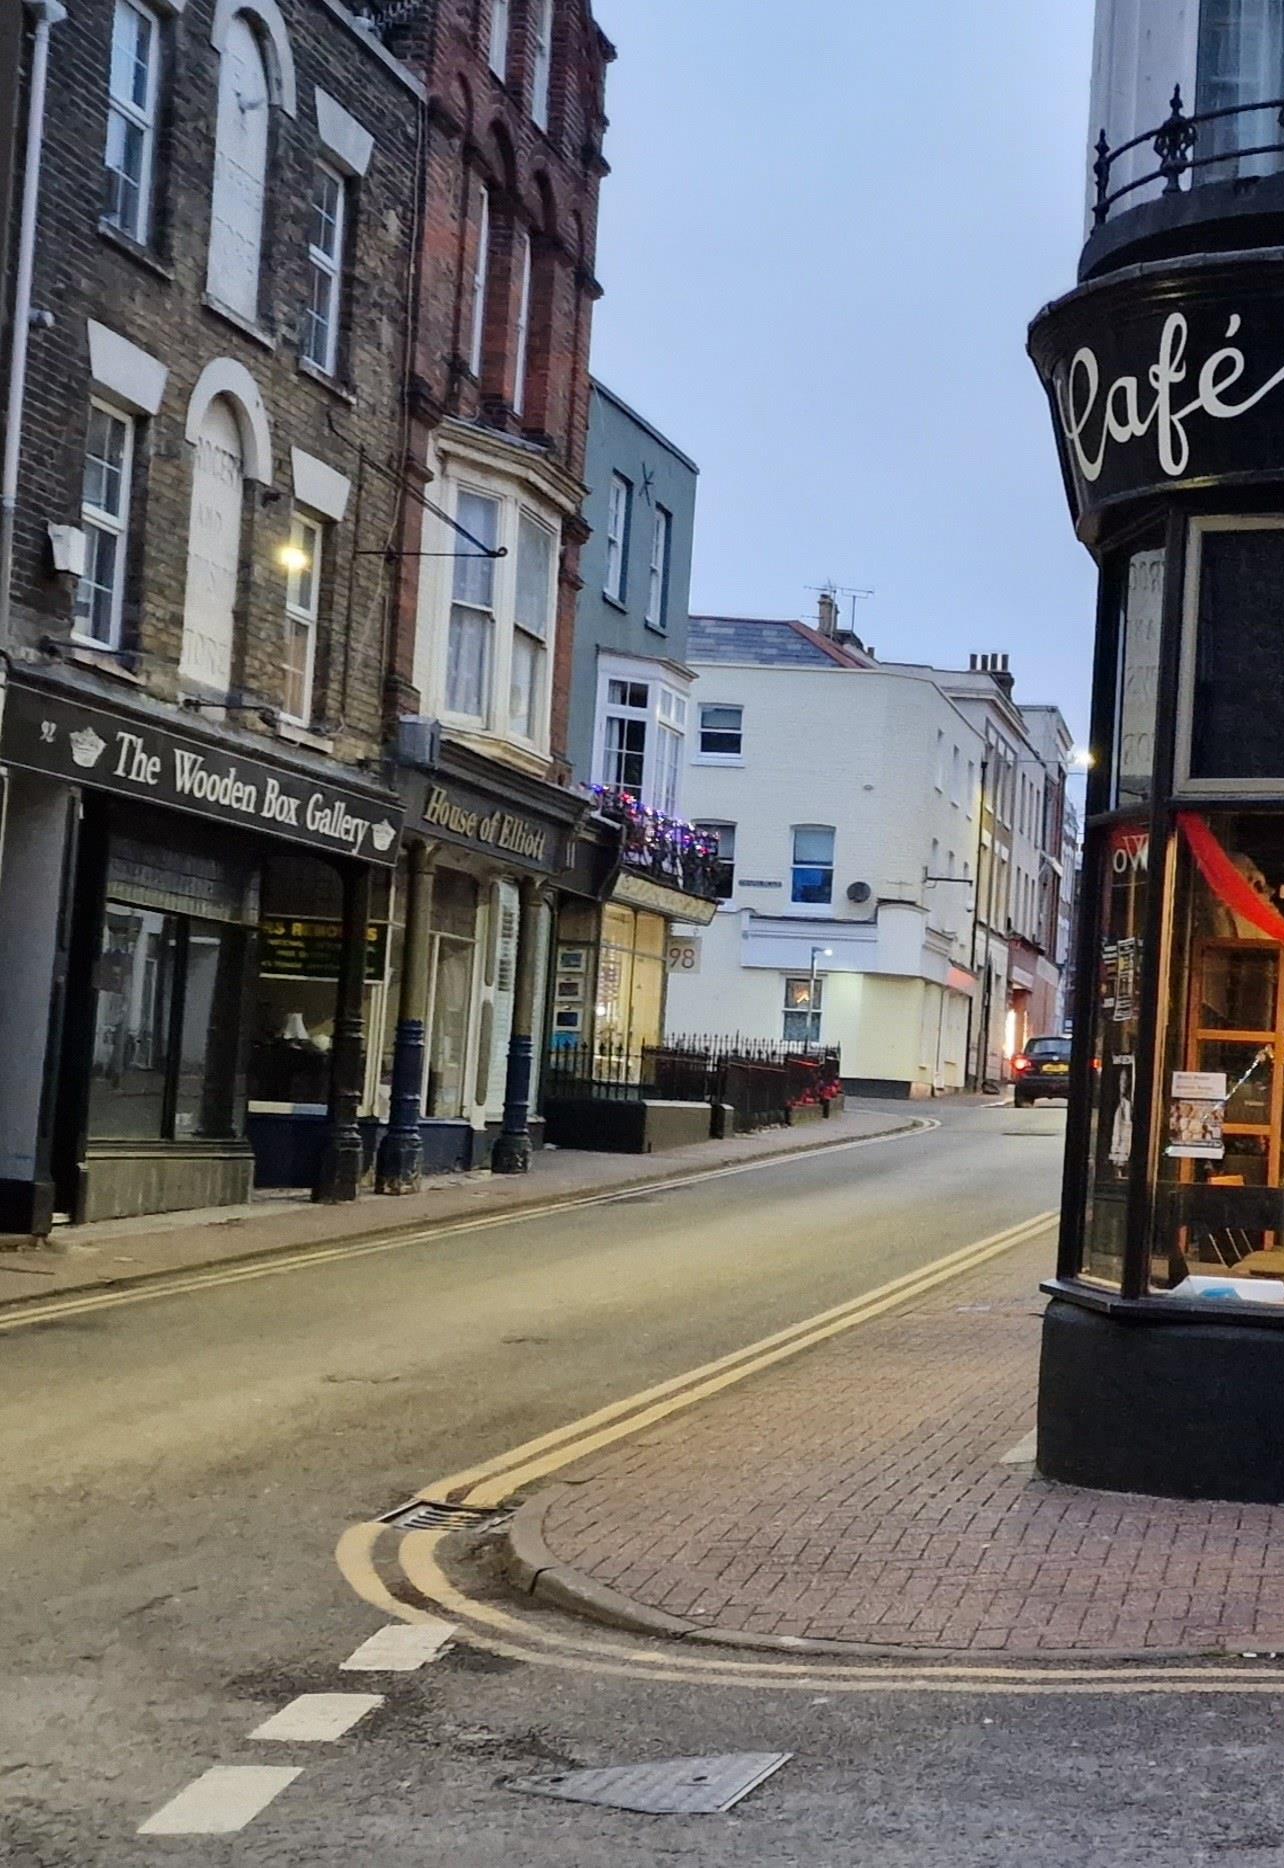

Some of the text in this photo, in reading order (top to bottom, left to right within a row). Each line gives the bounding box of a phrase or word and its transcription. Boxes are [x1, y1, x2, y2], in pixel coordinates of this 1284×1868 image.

[112, 731, 371, 856] The Wooden Box Gallery
[422, 784, 546, 862] House of Elliott
[669, 947, 695, 969] 98
